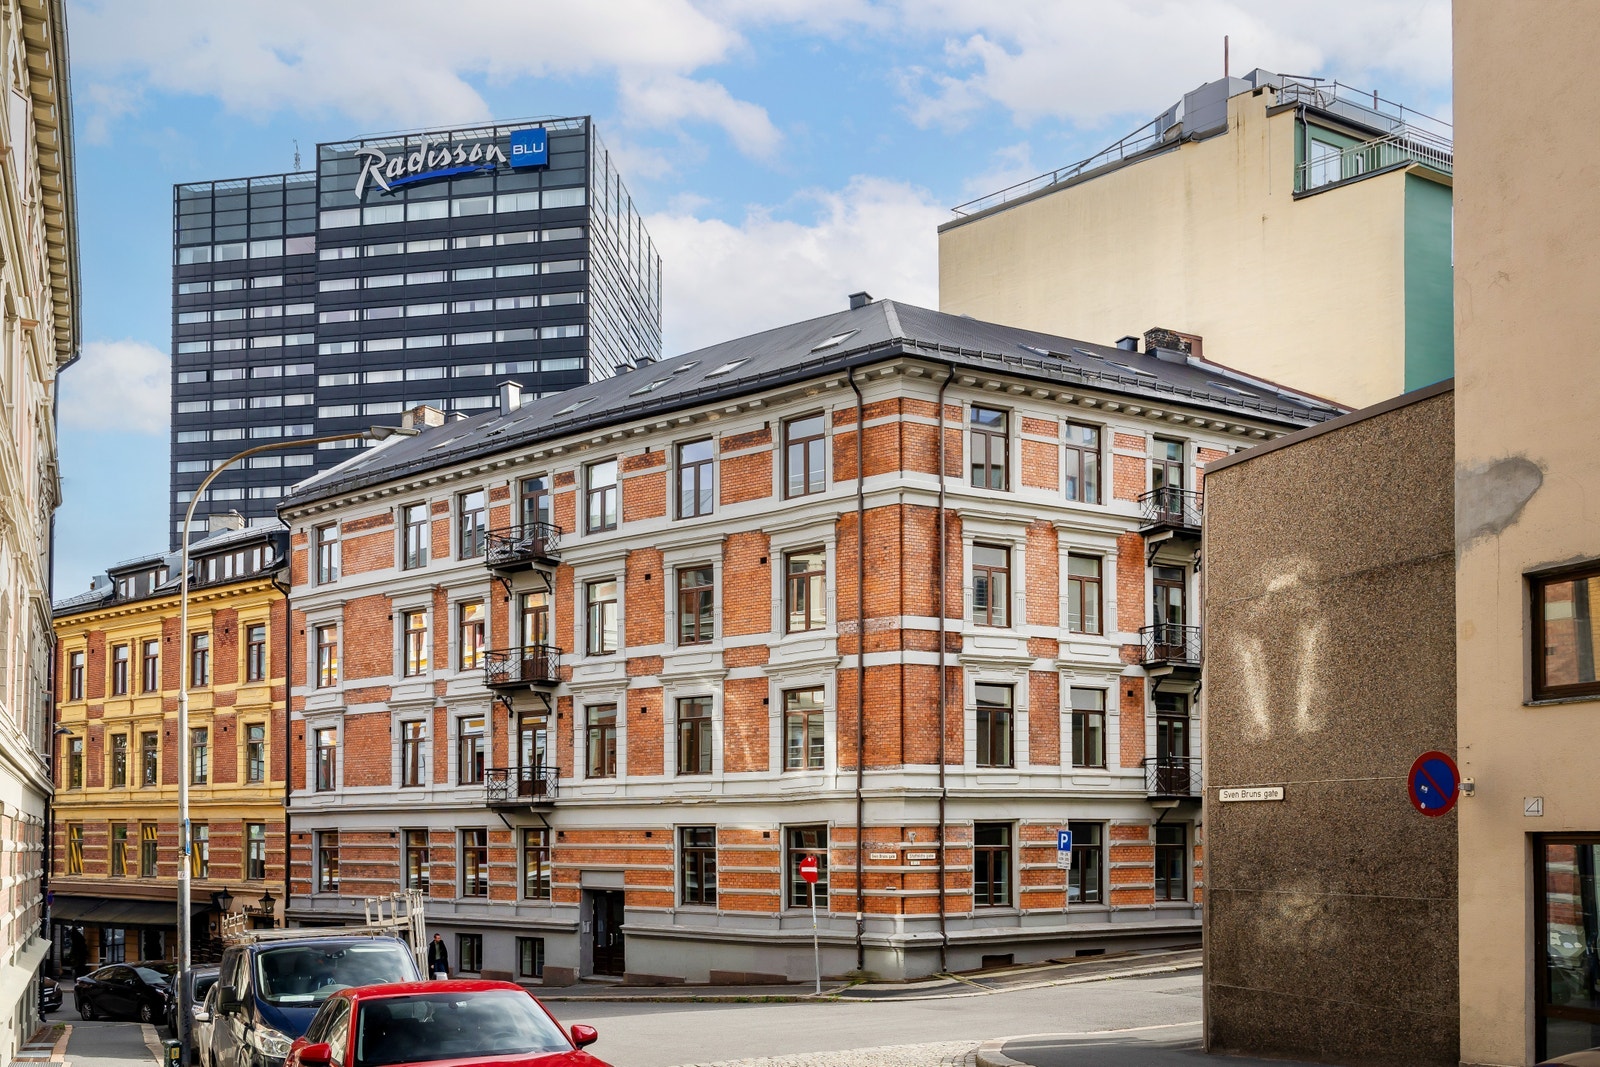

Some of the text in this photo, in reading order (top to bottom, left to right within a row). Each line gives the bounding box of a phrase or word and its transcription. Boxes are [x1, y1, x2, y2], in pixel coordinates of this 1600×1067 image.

[354, 133, 544, 200] Radisson BLU
[1223, 789, 1279, 799] Sven Bruns gate
[1525, 798, 1541, 815] 4
[1060, 833, 1069, 849] P
